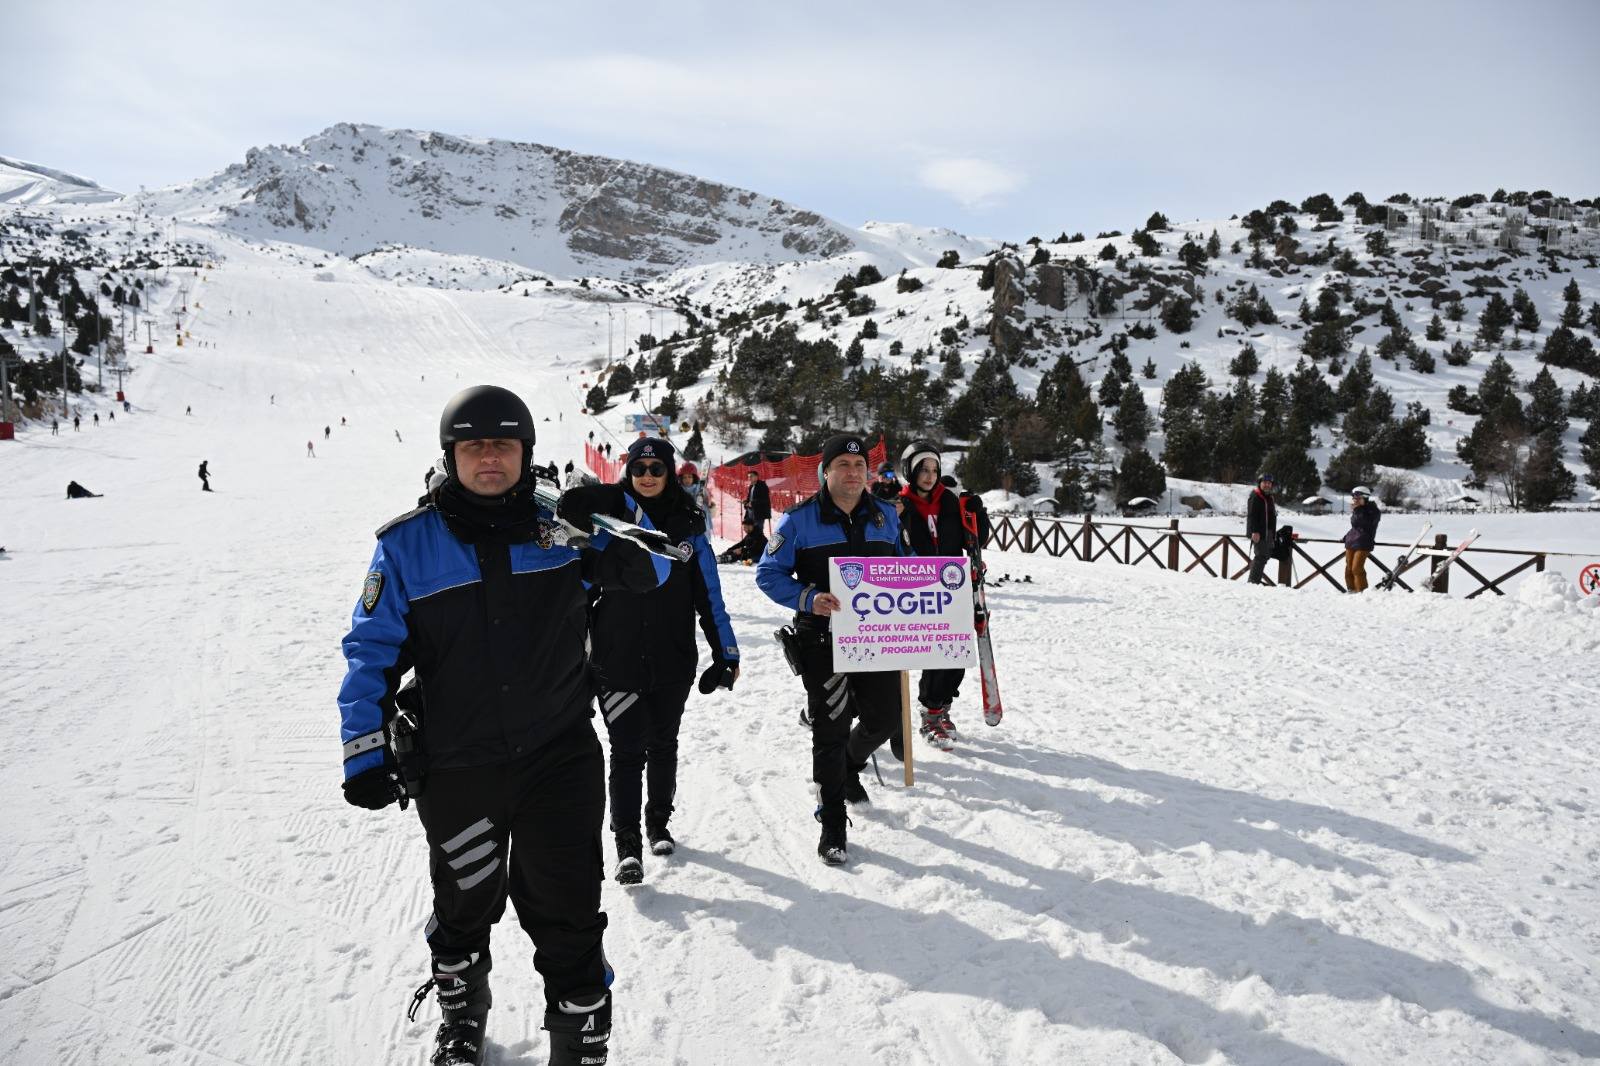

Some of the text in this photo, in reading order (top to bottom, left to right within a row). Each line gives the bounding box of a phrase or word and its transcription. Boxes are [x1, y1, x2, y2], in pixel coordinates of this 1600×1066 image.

[869, 562, 936, 575] ERZİNCAN
[852, 592, 952, 621] ÇOGEP
[858, 624, 892, 634] ÇOCUK
[907, 623, 950, 633] GENÇLER
[838, 633, 971, 644] SOSYAL KORUMA VE DESTEK
[881, 646, 931, 654] PROGRAMI
